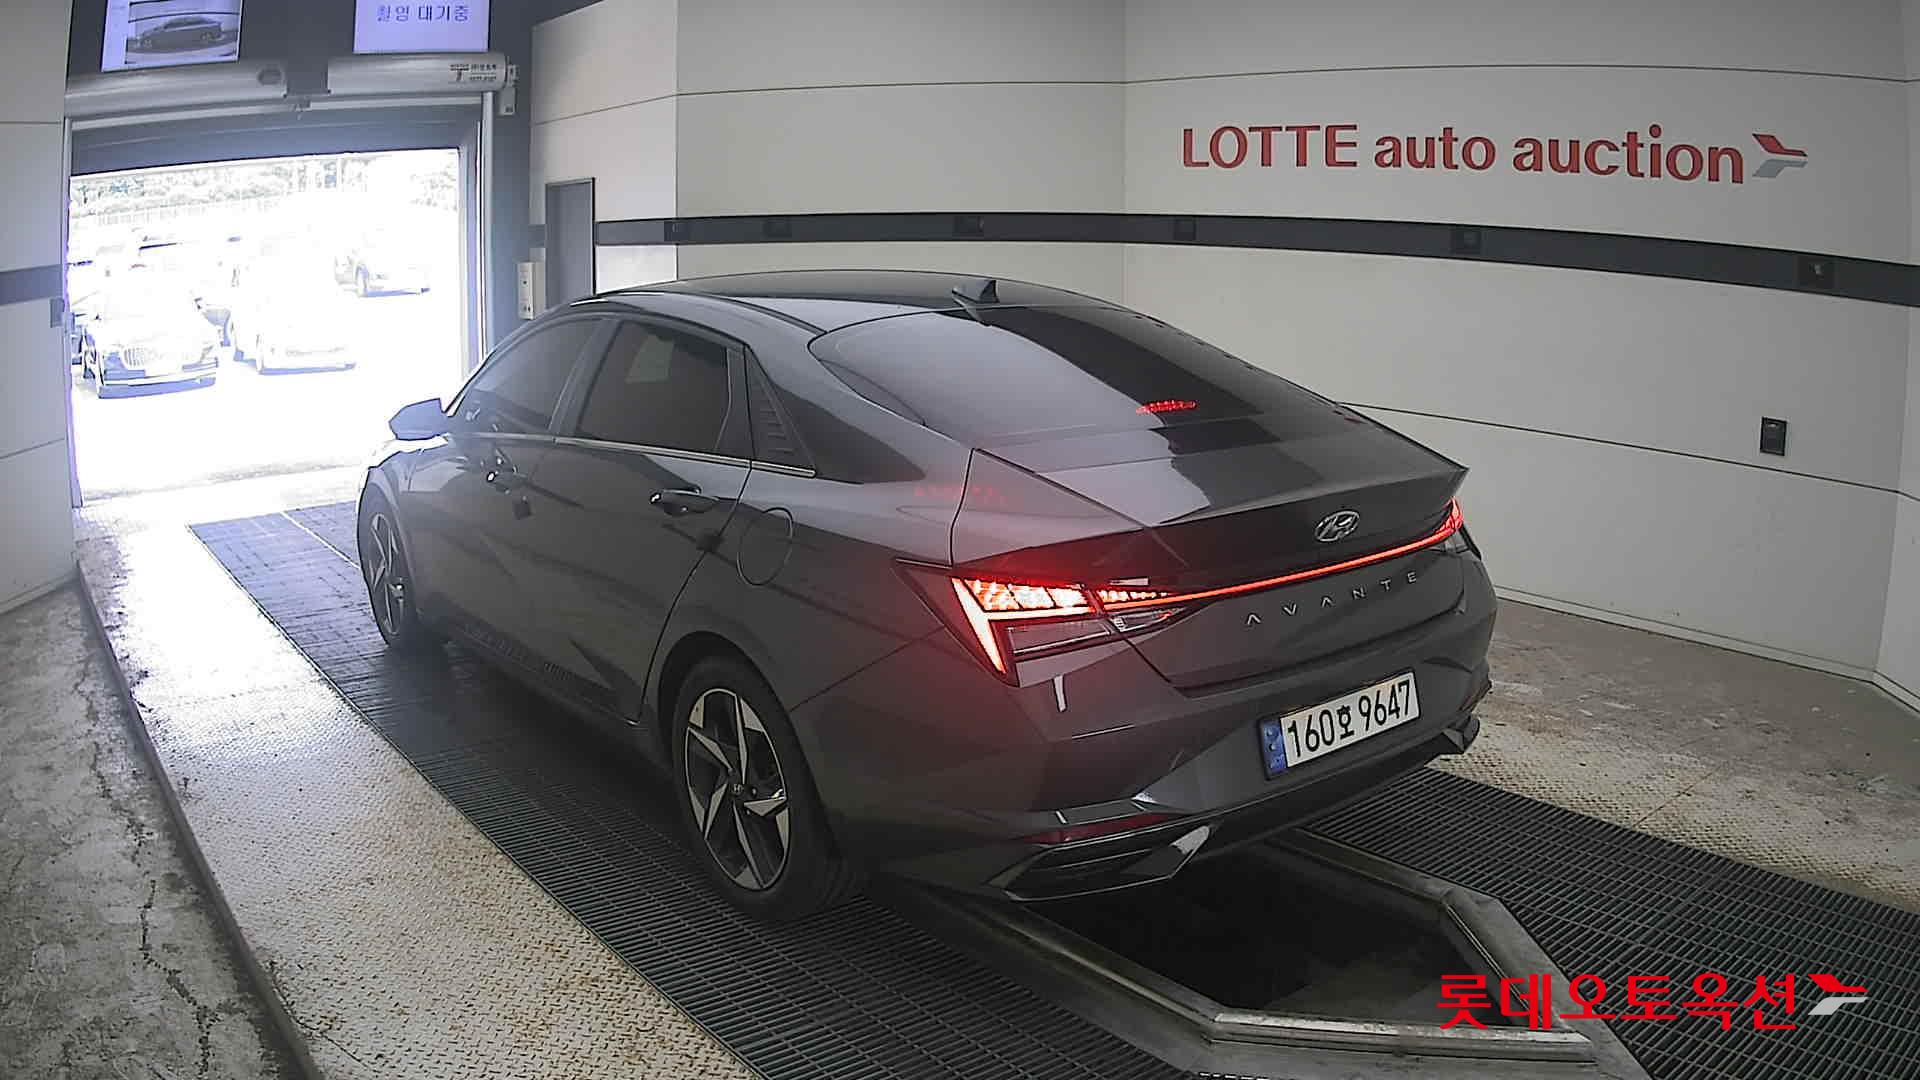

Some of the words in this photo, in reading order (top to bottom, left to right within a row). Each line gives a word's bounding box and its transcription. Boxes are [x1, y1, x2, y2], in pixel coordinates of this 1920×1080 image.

[418, 4, 469, 21] 대기중
[1183, 124, 1358, 168] LOTTE
[1374, 127, 1496, 170] auto
[1512, 124, 1744, 184] auction
[1245, 571, 1418, 626] AVANTE
